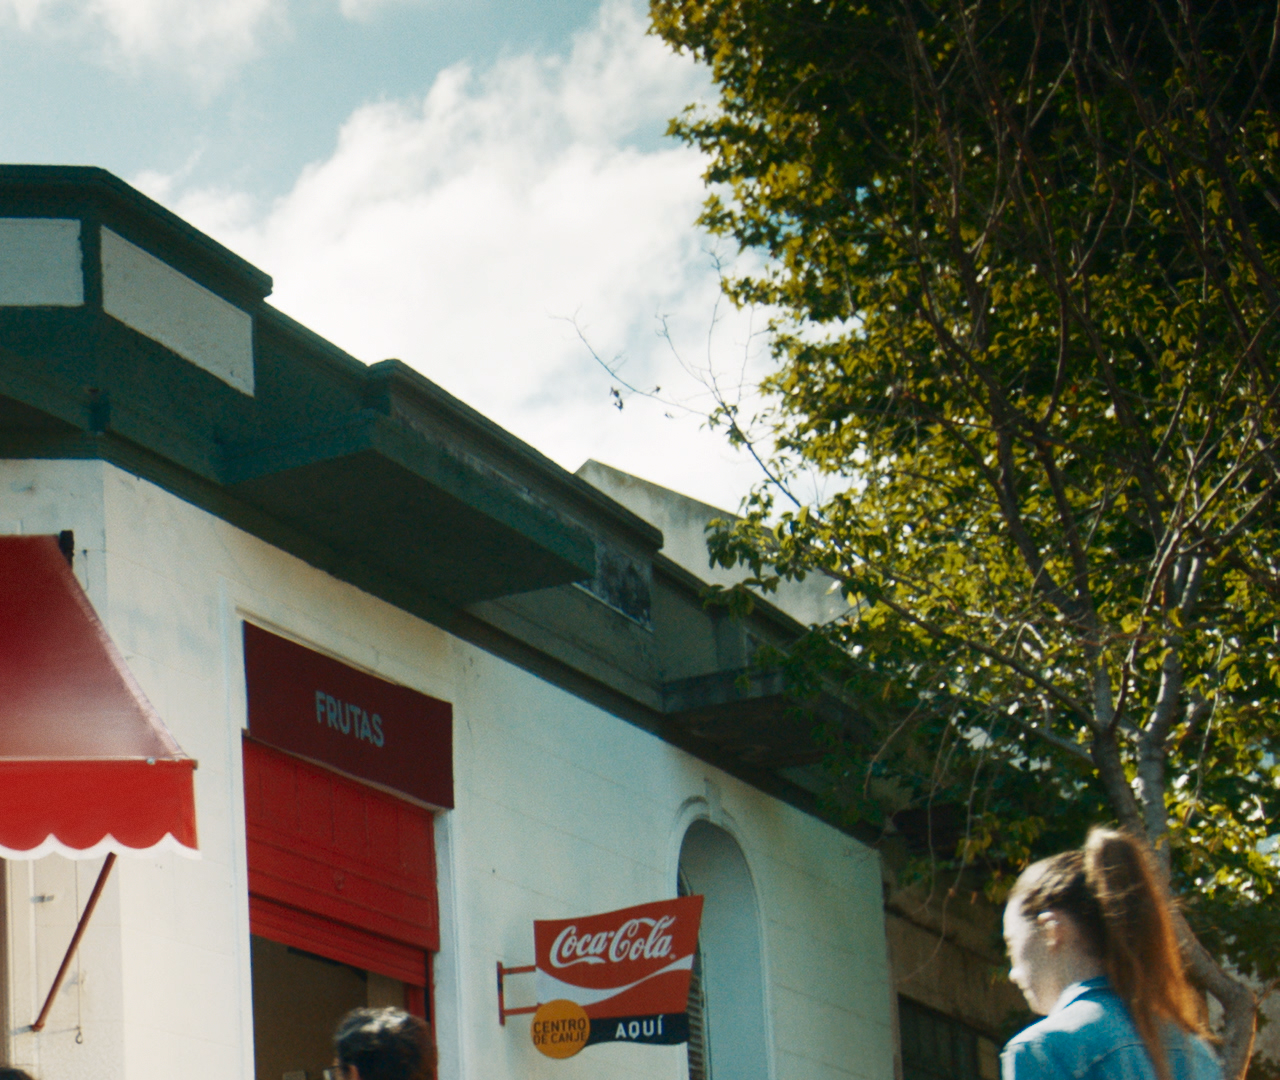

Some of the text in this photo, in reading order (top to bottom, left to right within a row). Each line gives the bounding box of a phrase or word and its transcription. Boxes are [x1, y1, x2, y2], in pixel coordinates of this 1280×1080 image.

[315, 691, 385, 748] FRUTAS
[549, 915, 676, 969] Coca-Cola
[533, 1030, 586, 1046] DE CANJE
[534, 1017, 587, 1035] CENTRO
[615, 1015, 663, 1039] AQUÍ
